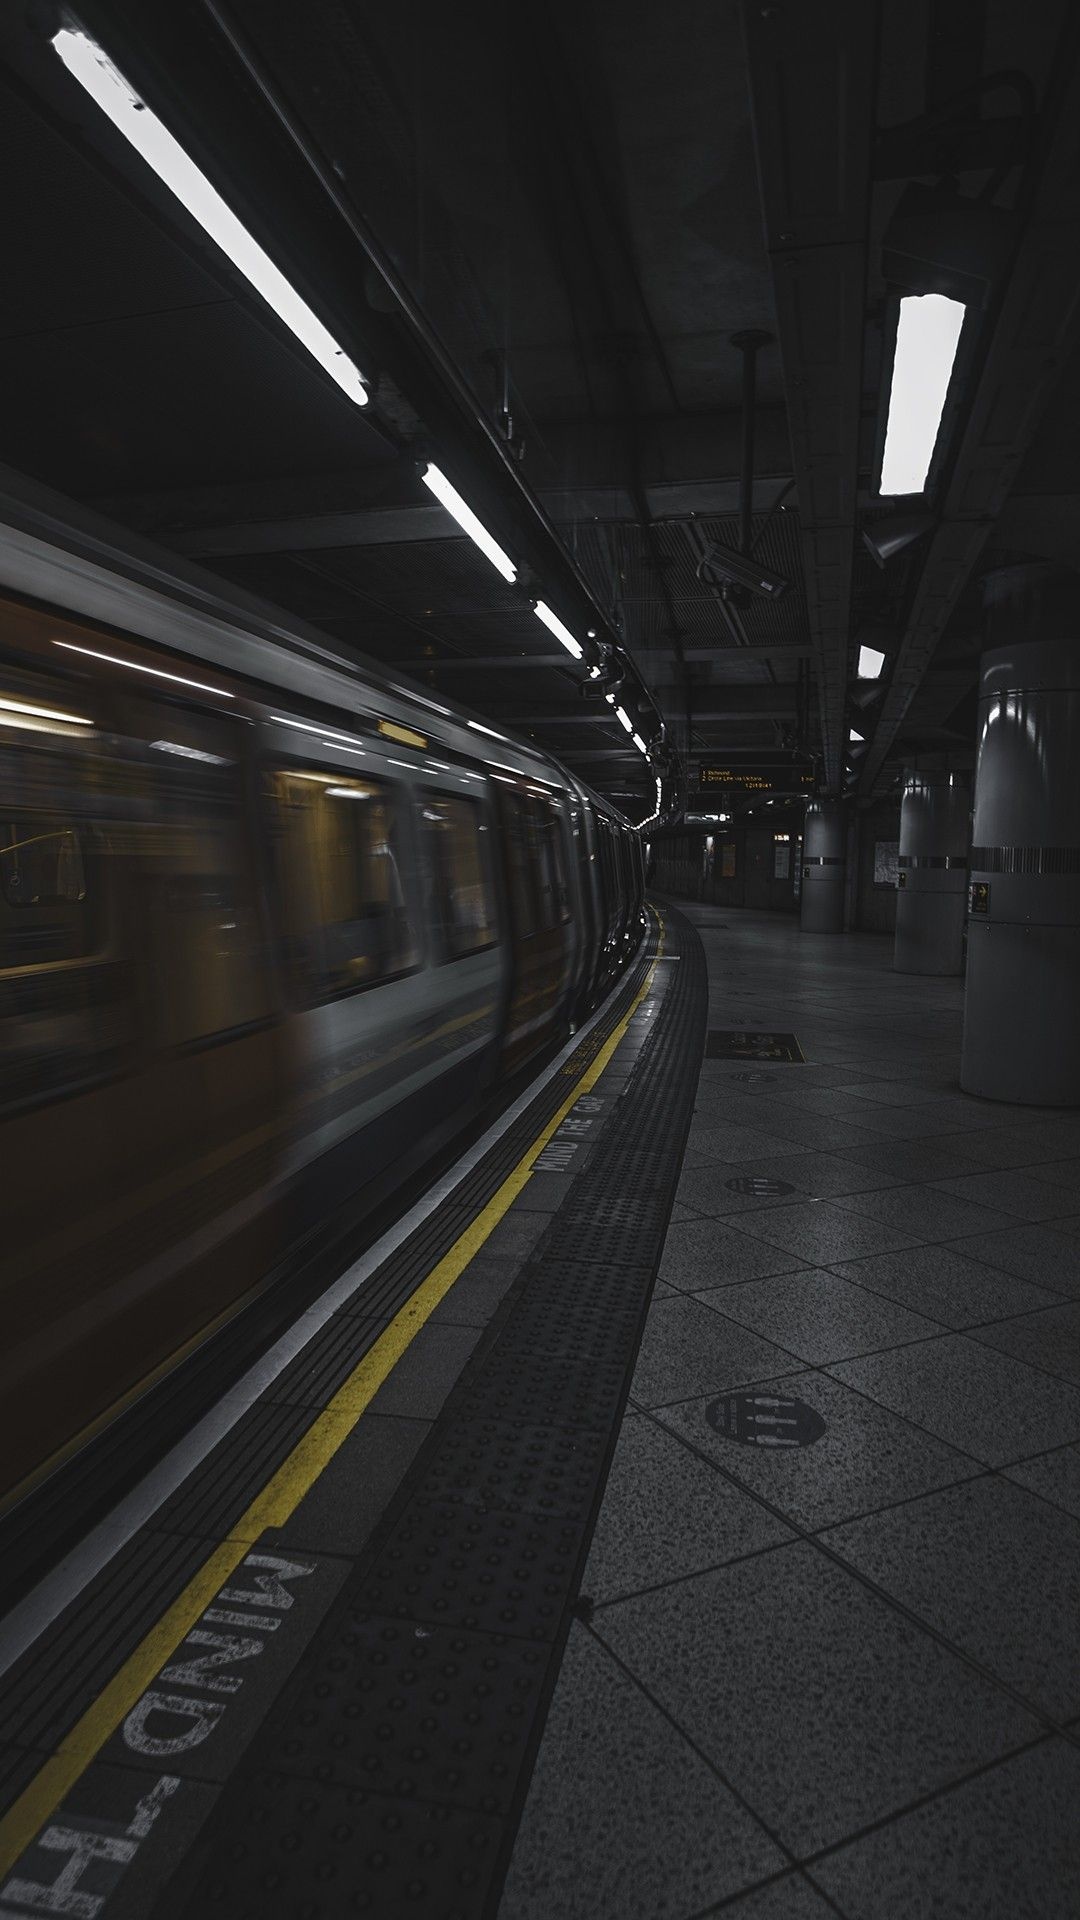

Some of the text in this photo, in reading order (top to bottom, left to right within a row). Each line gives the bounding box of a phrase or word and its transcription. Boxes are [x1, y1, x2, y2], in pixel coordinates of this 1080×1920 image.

[573, 1096, 605, 1112] GAP
[556, 1118, 593, 1136] THE
[533, 1141, 578, 1172] MIND
[122, 1554, 318, 1757] MIND
